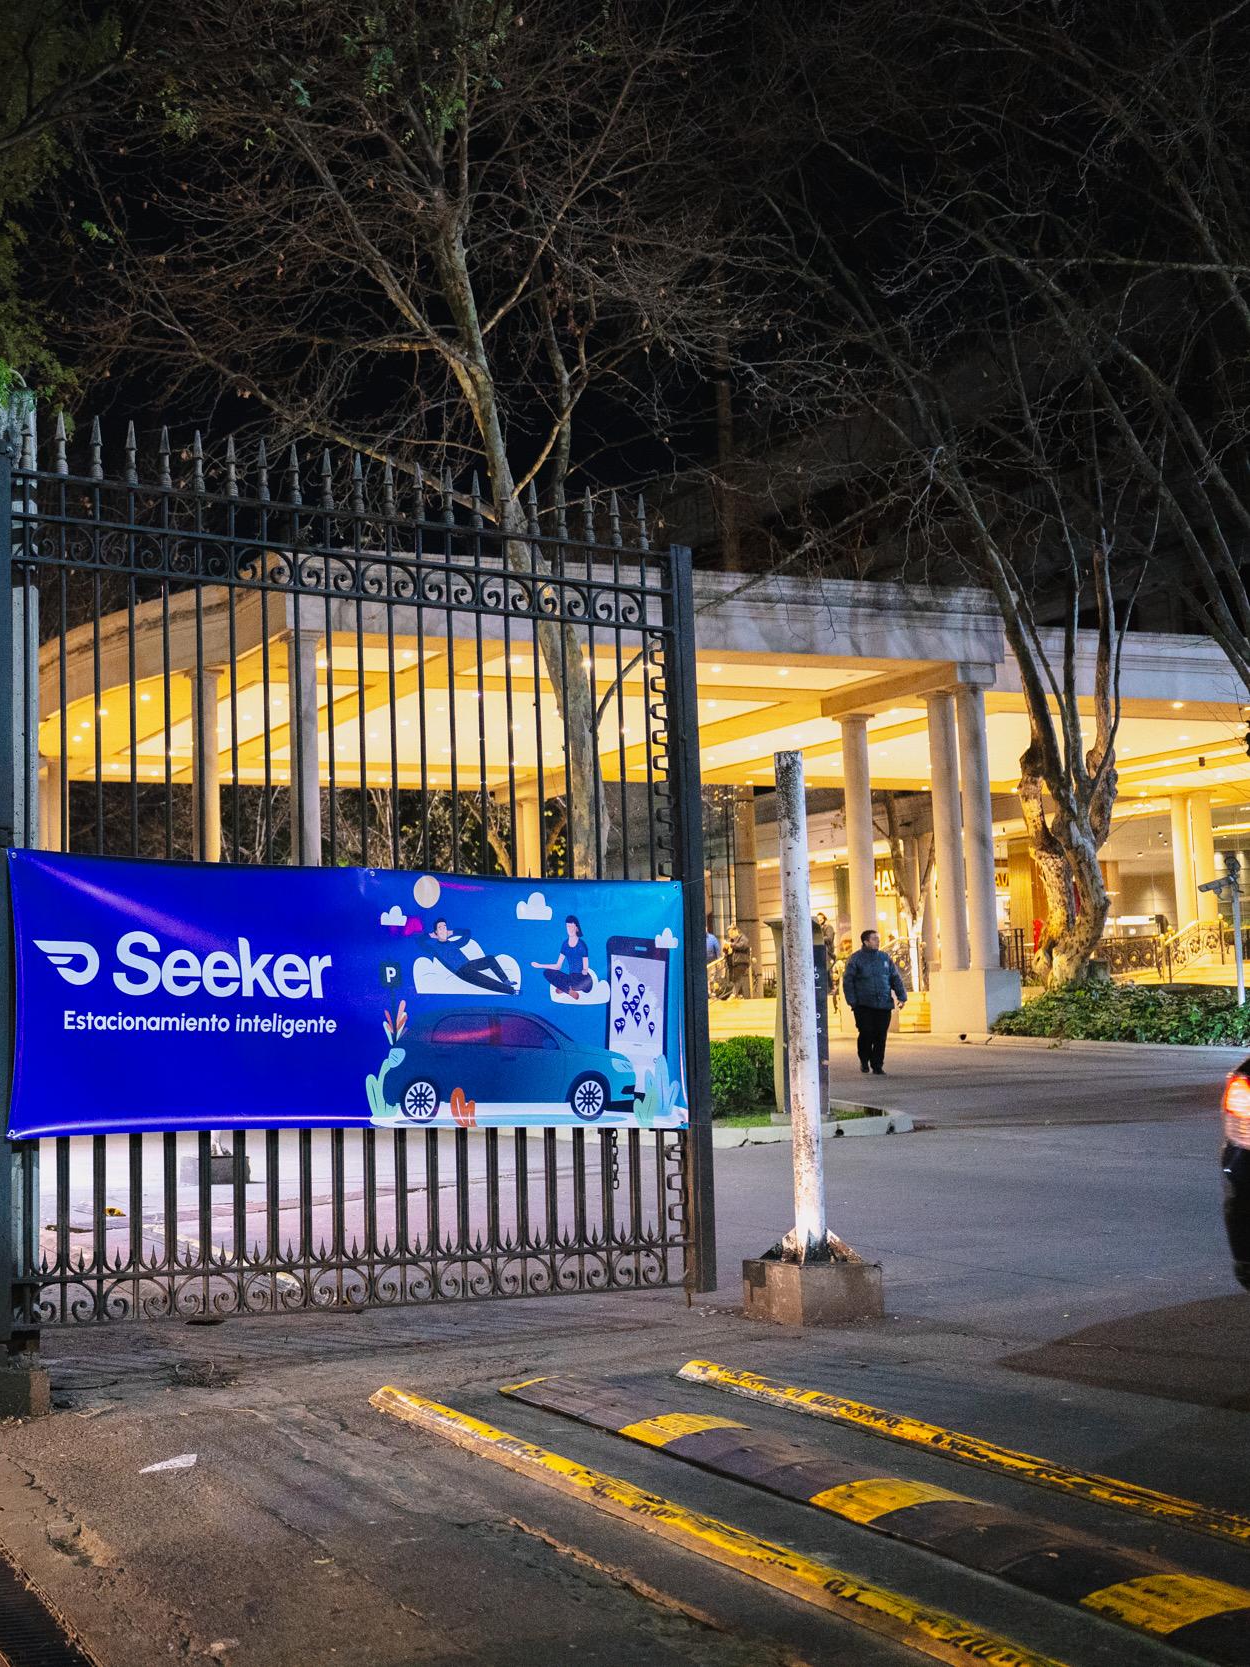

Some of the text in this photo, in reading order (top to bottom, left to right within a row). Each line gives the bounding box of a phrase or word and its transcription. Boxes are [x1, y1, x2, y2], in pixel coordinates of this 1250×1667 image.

[112, 930, 333, 999] Seeker
[385, 966, 397, 983] P
[63, 1009, 338, 1039] Estacionamiento inteligente
